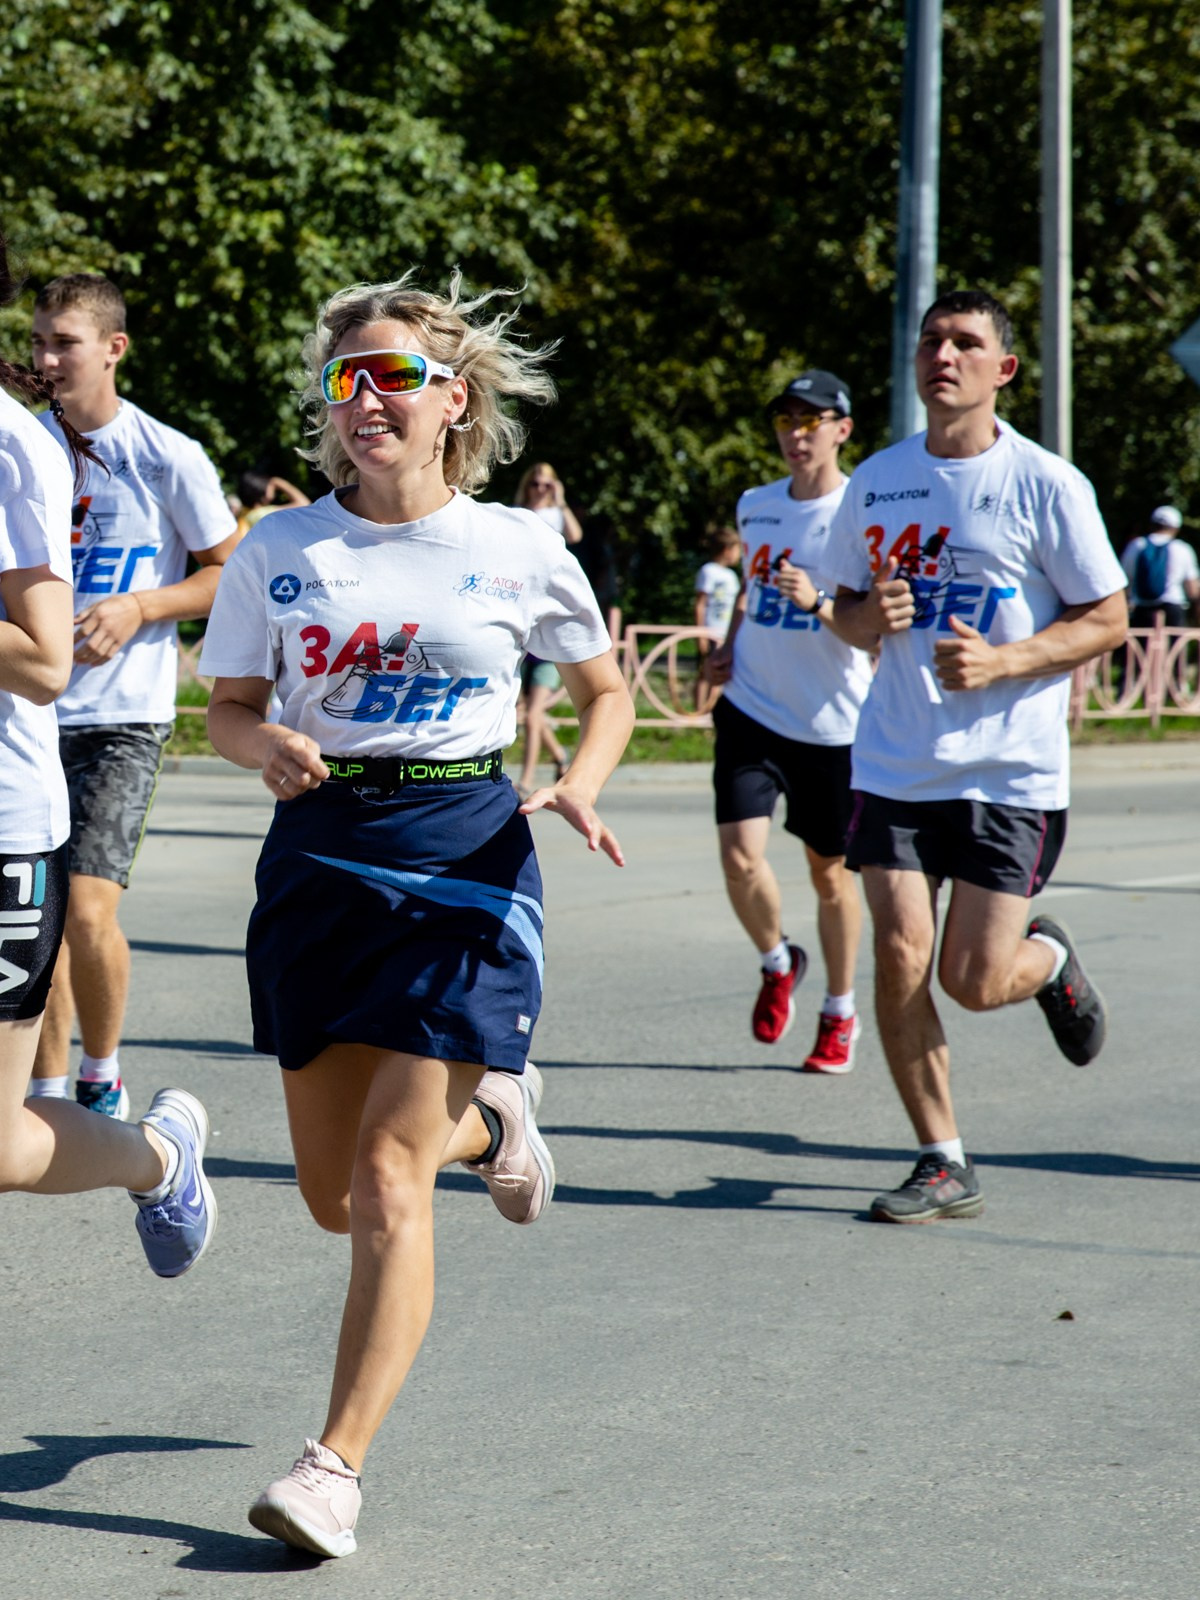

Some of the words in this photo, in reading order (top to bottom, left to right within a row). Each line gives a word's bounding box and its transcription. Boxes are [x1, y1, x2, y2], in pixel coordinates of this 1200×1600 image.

[876, 488, 930, 502] РОСАТОМ
[864, 523, 952, 576] ЗА!
[305, 579, 360, 592] РОСАТОМ
[485, 586, 521, 602] СПОРТ
[492, 576, 524, 593] АТОМ
[755, 584, 834, 632] БЕ
[299, 622, 420, 678] ЗА!
[351, 674, 489, 724] БЕГ
